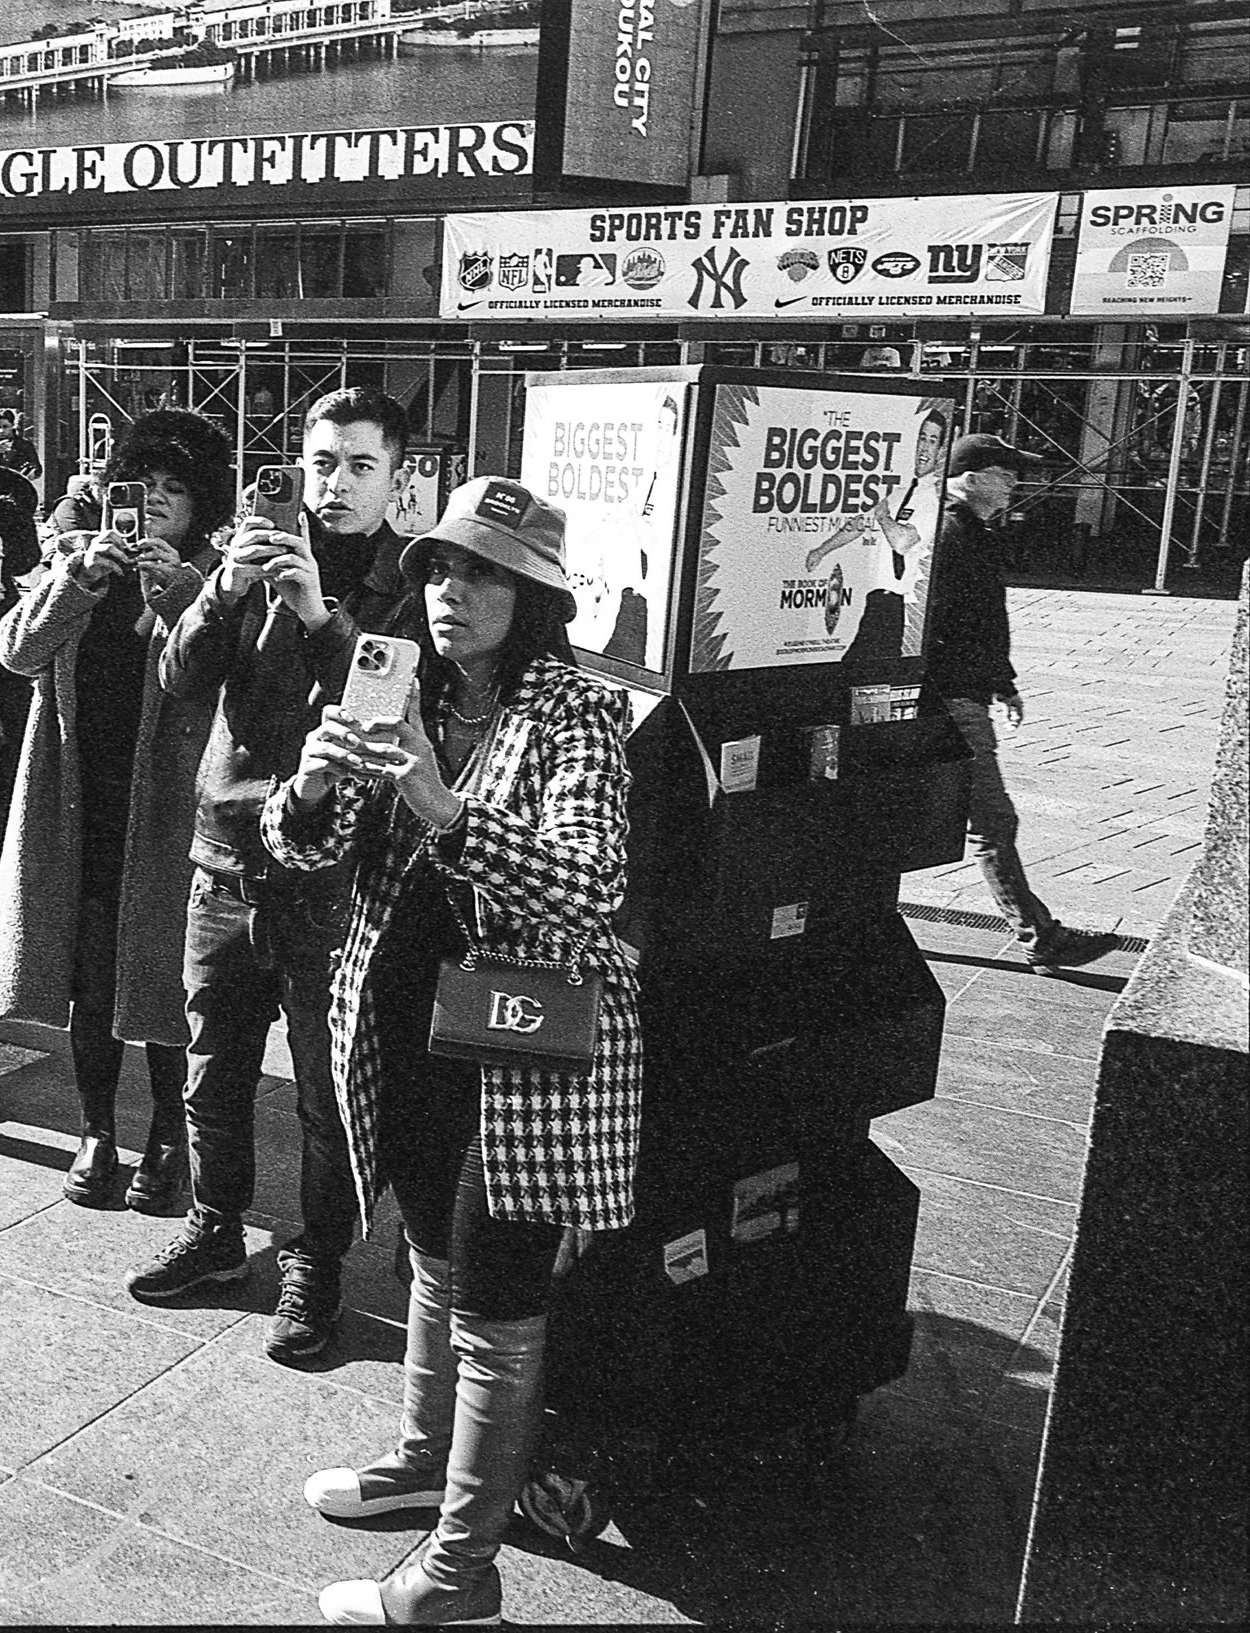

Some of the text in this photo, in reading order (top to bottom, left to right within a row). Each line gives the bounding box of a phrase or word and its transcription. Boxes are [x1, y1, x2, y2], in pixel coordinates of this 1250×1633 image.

[632, 57, 651, 137] CITY
[123, 122, 530, 189] OUTFITTERS
[590, 205, 869, 242] SPORTS FAN SHOP
[1111, 225, 1197, 236] SCAFFOLDING
[465, 259, 488, 284] NHL
[830, 249, 865, 265] NETS
[501, 269, 525, 284] NFL
[487, 298, 663, 310] OFFICIALLY LICENSED MERCHANDISE
[811, 294, 1022, 306] OFFICIALLY LICENSED MERCHANDISE
[553, 422, 643, 461] BIGGEST
[763, 427, 902, 472] BIGGEST
[547, 461, 644, 503] BOLDEST
[752, 471, 901, 514] BOLDEST
[767, 516, 881, 533] FUNNIEST MUSICAL
[486, 989, 545, 1034] DG
